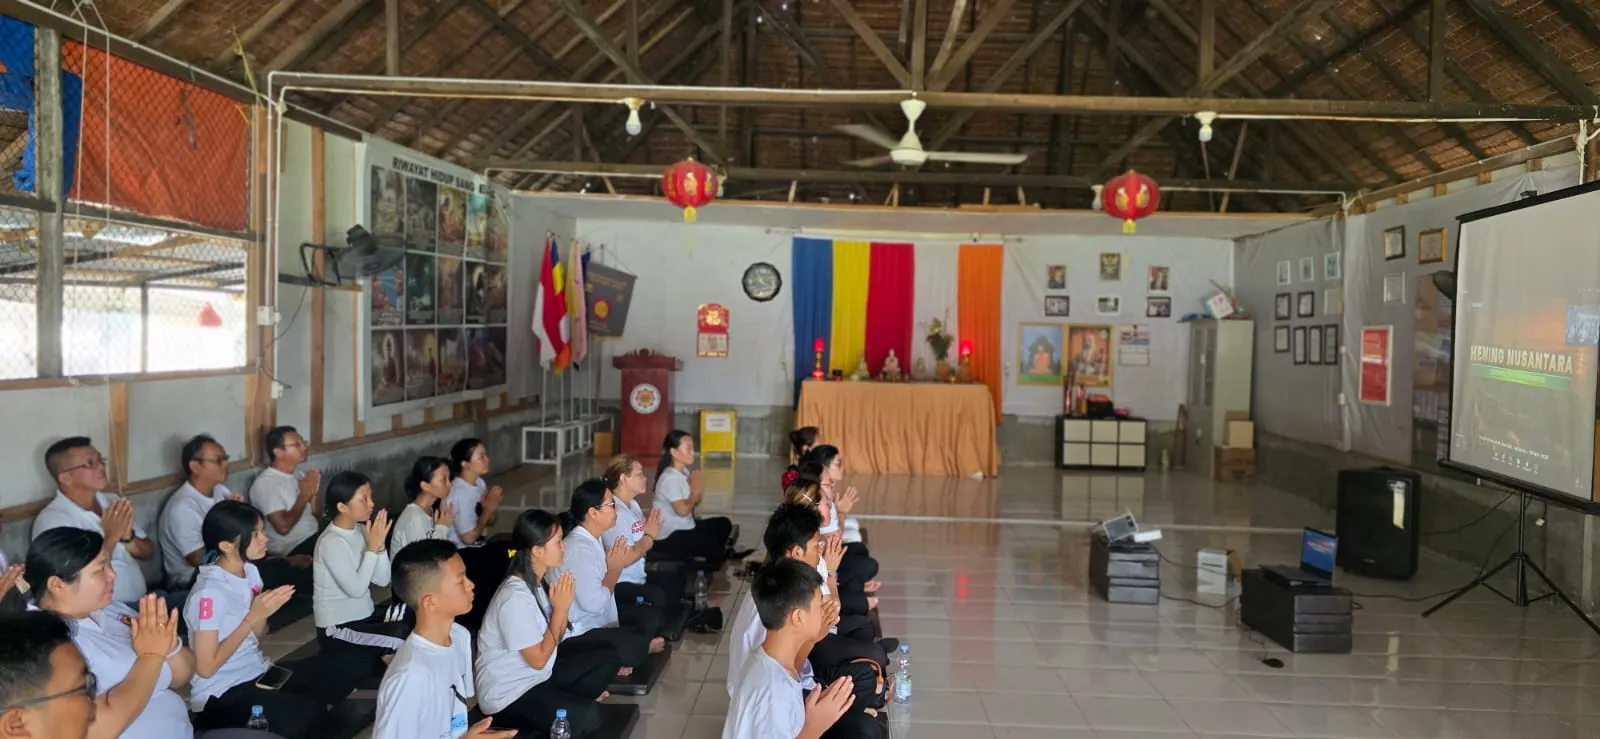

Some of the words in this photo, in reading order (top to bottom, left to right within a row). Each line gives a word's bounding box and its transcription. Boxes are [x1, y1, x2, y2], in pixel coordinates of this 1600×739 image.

[392, 155, 429, 178] RIWAYAT
[1470, 344, 1504, 365] HENING
[1506, 348, 1573, 375] NUSANTARA
